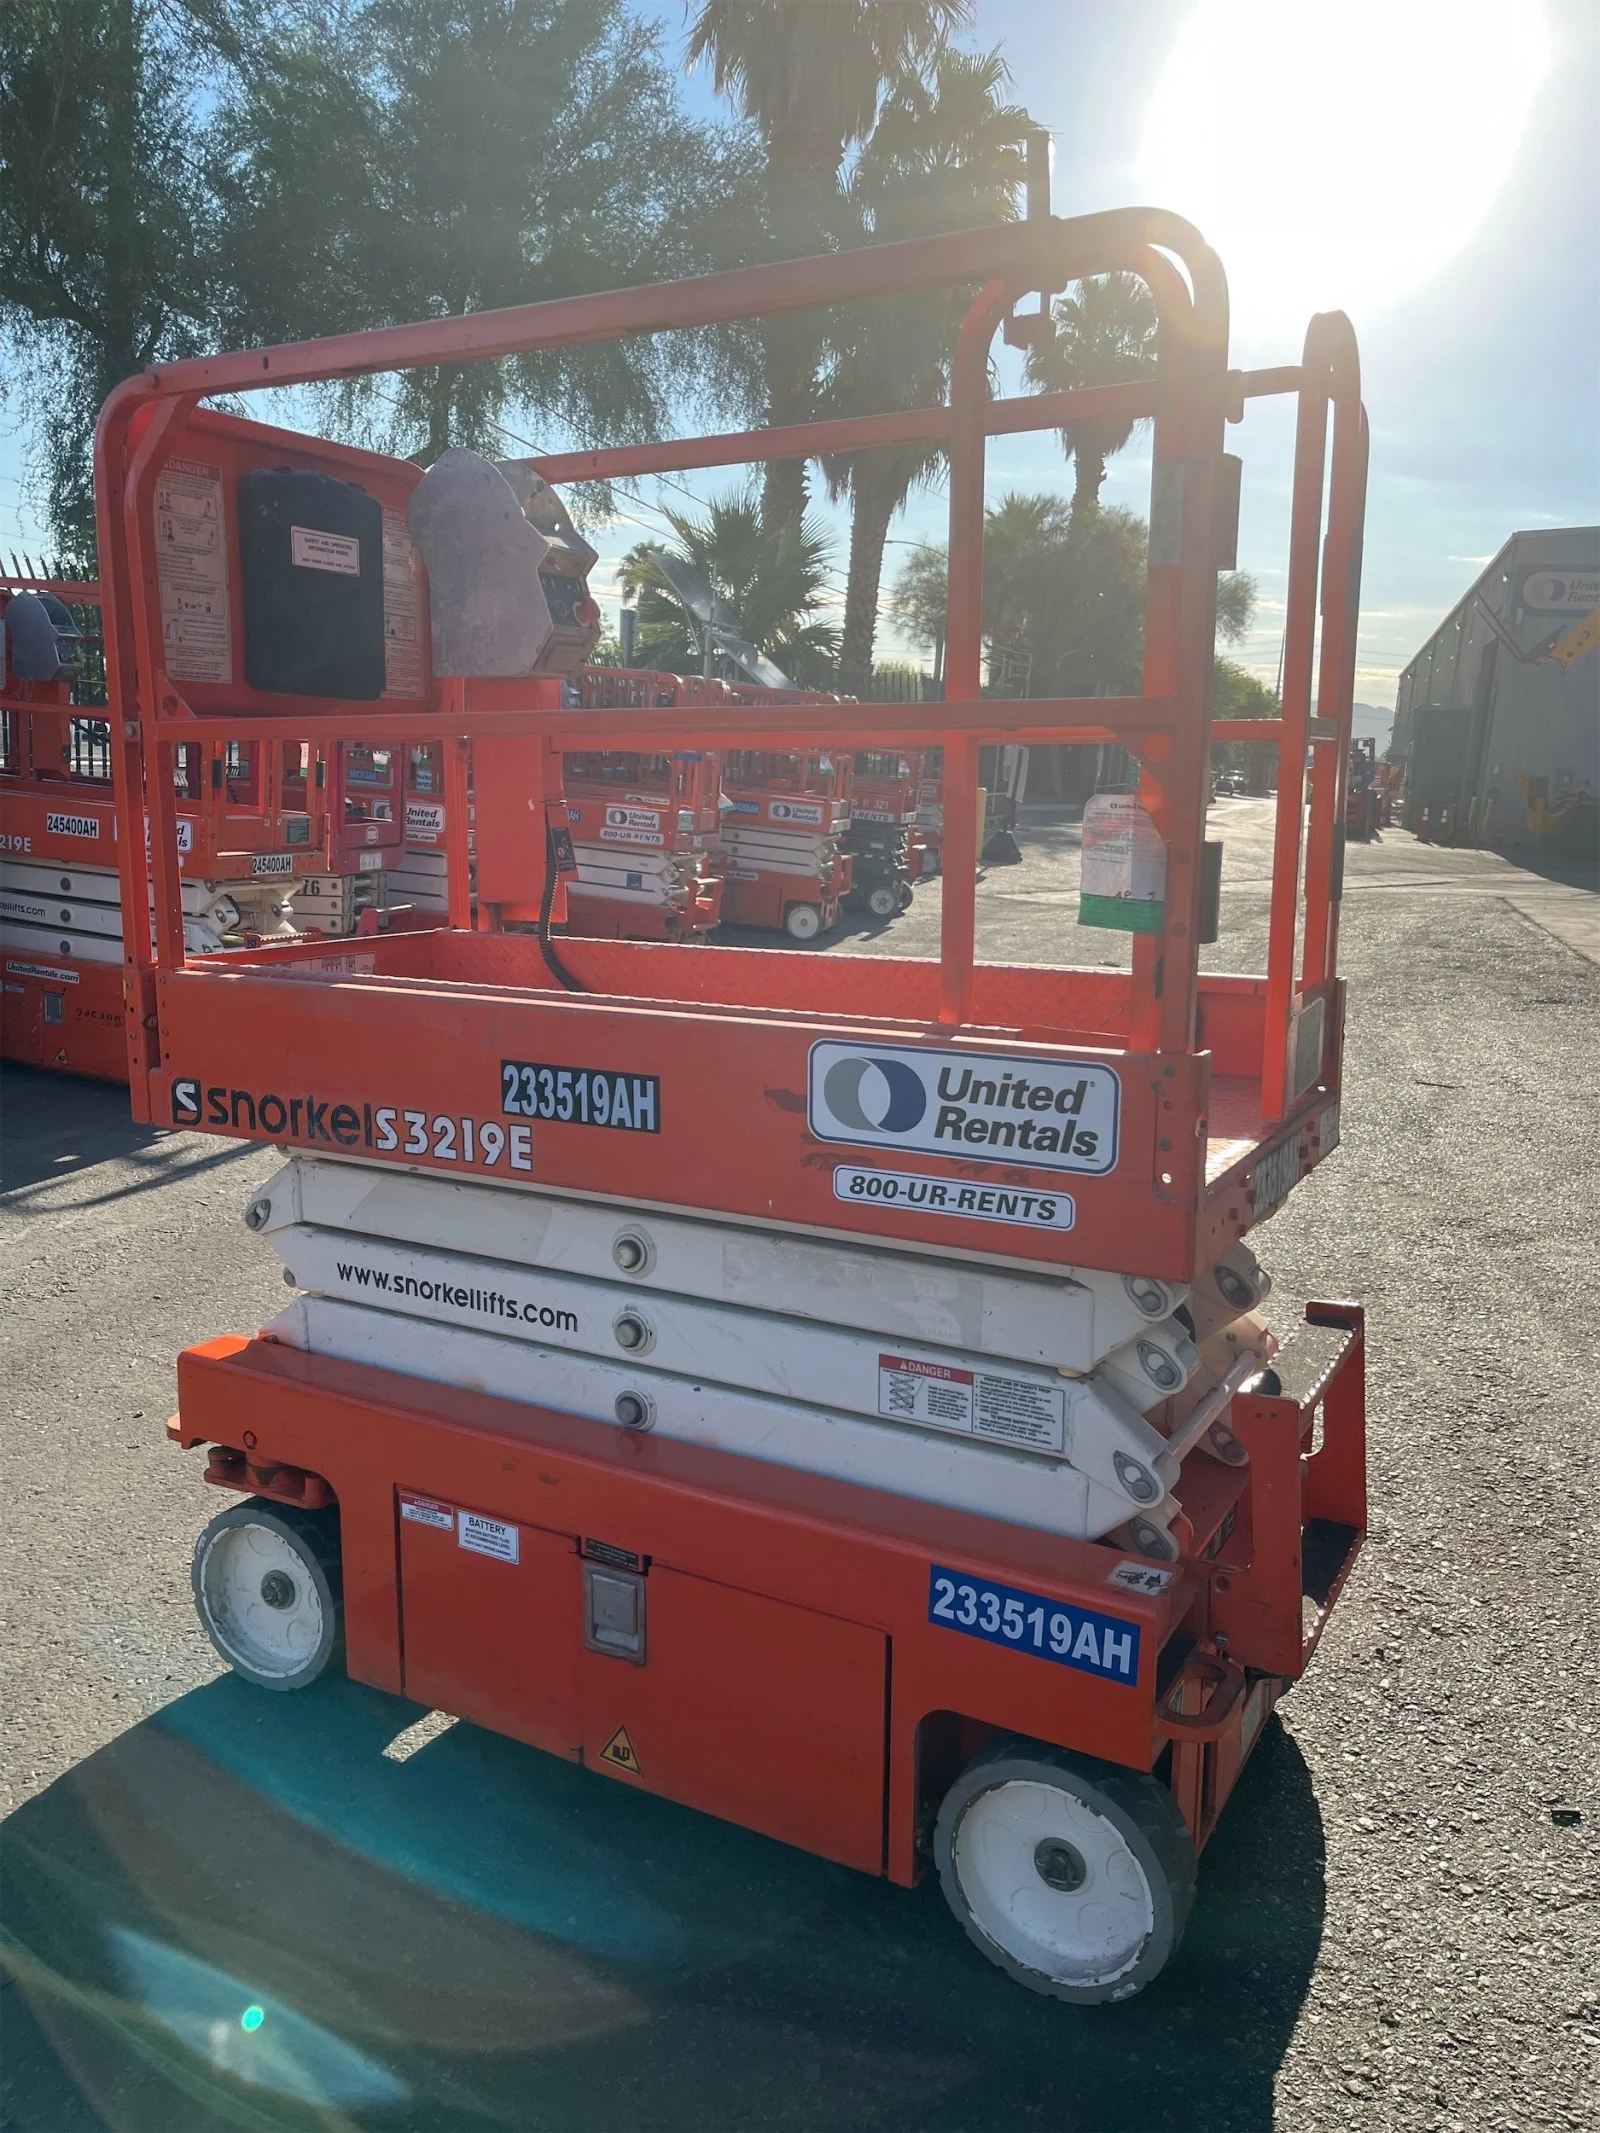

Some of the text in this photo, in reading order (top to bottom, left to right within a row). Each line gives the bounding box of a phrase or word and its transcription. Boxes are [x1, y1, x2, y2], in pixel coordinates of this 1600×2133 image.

[168, 459, 209, 477] DANGER
[47, 815, 98, 837] 245400AH
[628, 819, 656, 829] Rentals
[629, 812, 655, 822] United
[252, 856, 292, 874] 245400AH
[7, 962, 79, 983] UnitedRentals.com
[503, 1064, 655, 1131] 233519AH
[937, 1066, 1087, 1115] United
[207, 1087, 373, 1149] snorkel
[374, 1106, 533, 1172] S3219E
[934, 1105, 1099, 1157] Rentals
[849, 1175, 1057, 1221] 800-UR-RENTS
[337, 1262, 578, 1333] www.snorkellifts.com
[908, 1361, 951, 1379] DANGER
[468, 1516, 506, 1536] BATTERY
[933, 1577, 1132, 1675] 233519AH
